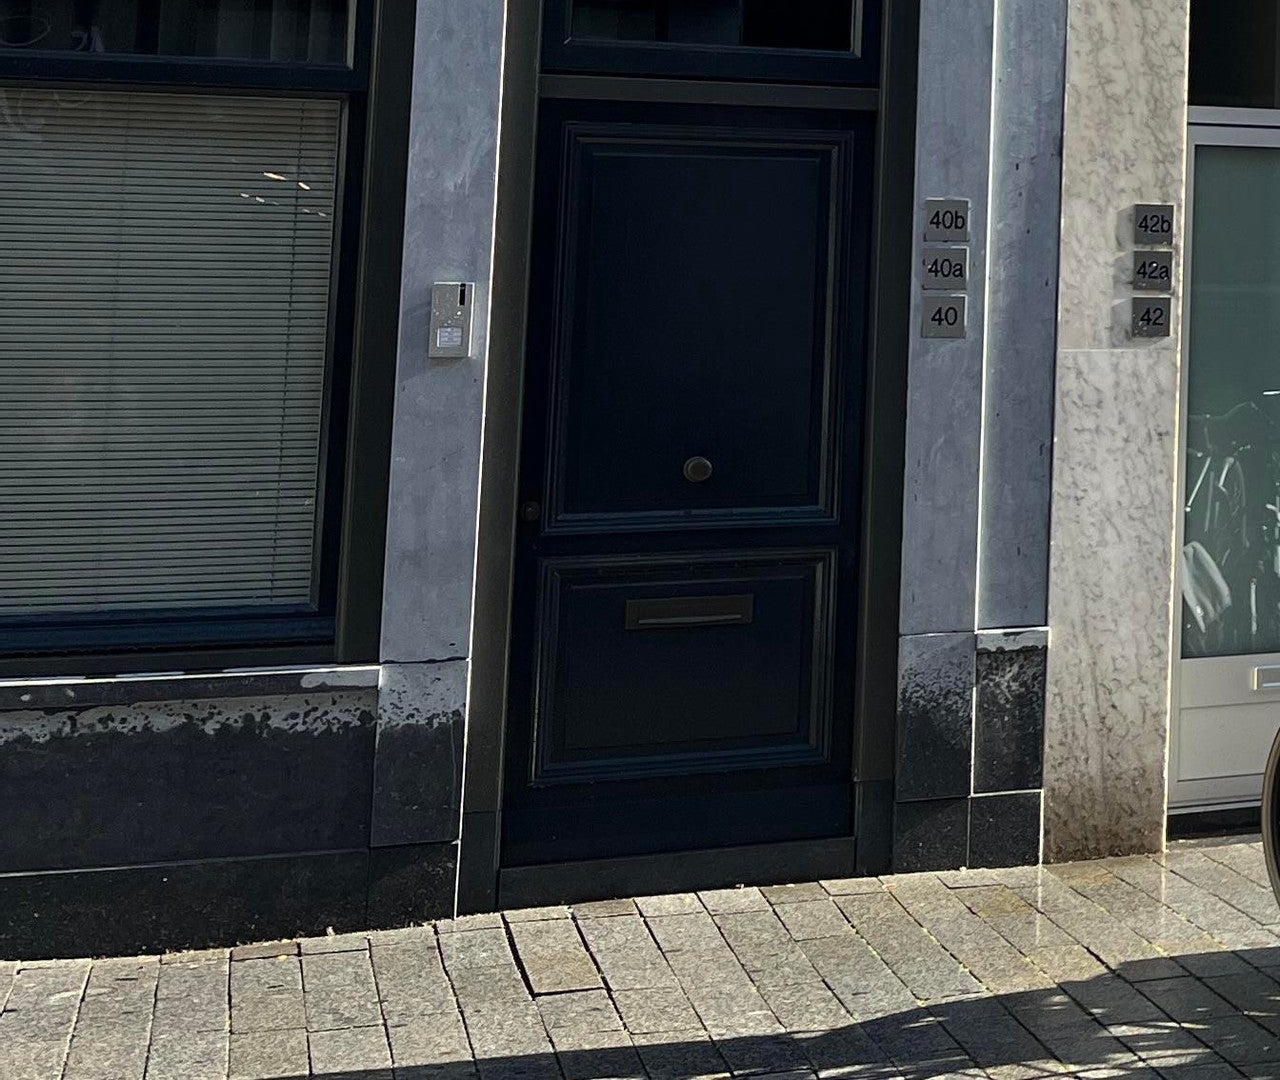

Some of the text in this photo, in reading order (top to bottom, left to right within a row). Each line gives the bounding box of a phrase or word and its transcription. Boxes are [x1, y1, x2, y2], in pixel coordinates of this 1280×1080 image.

[929, 210, 966, 230] 40b
[1138, 215, 1171, 233] 42b
[928, 258, 964, 278] 40a
[1136, 262, 1170, 280] 42a
[931, 306, 958, 326] 40
[1140, 308, 1164, 326] 42
